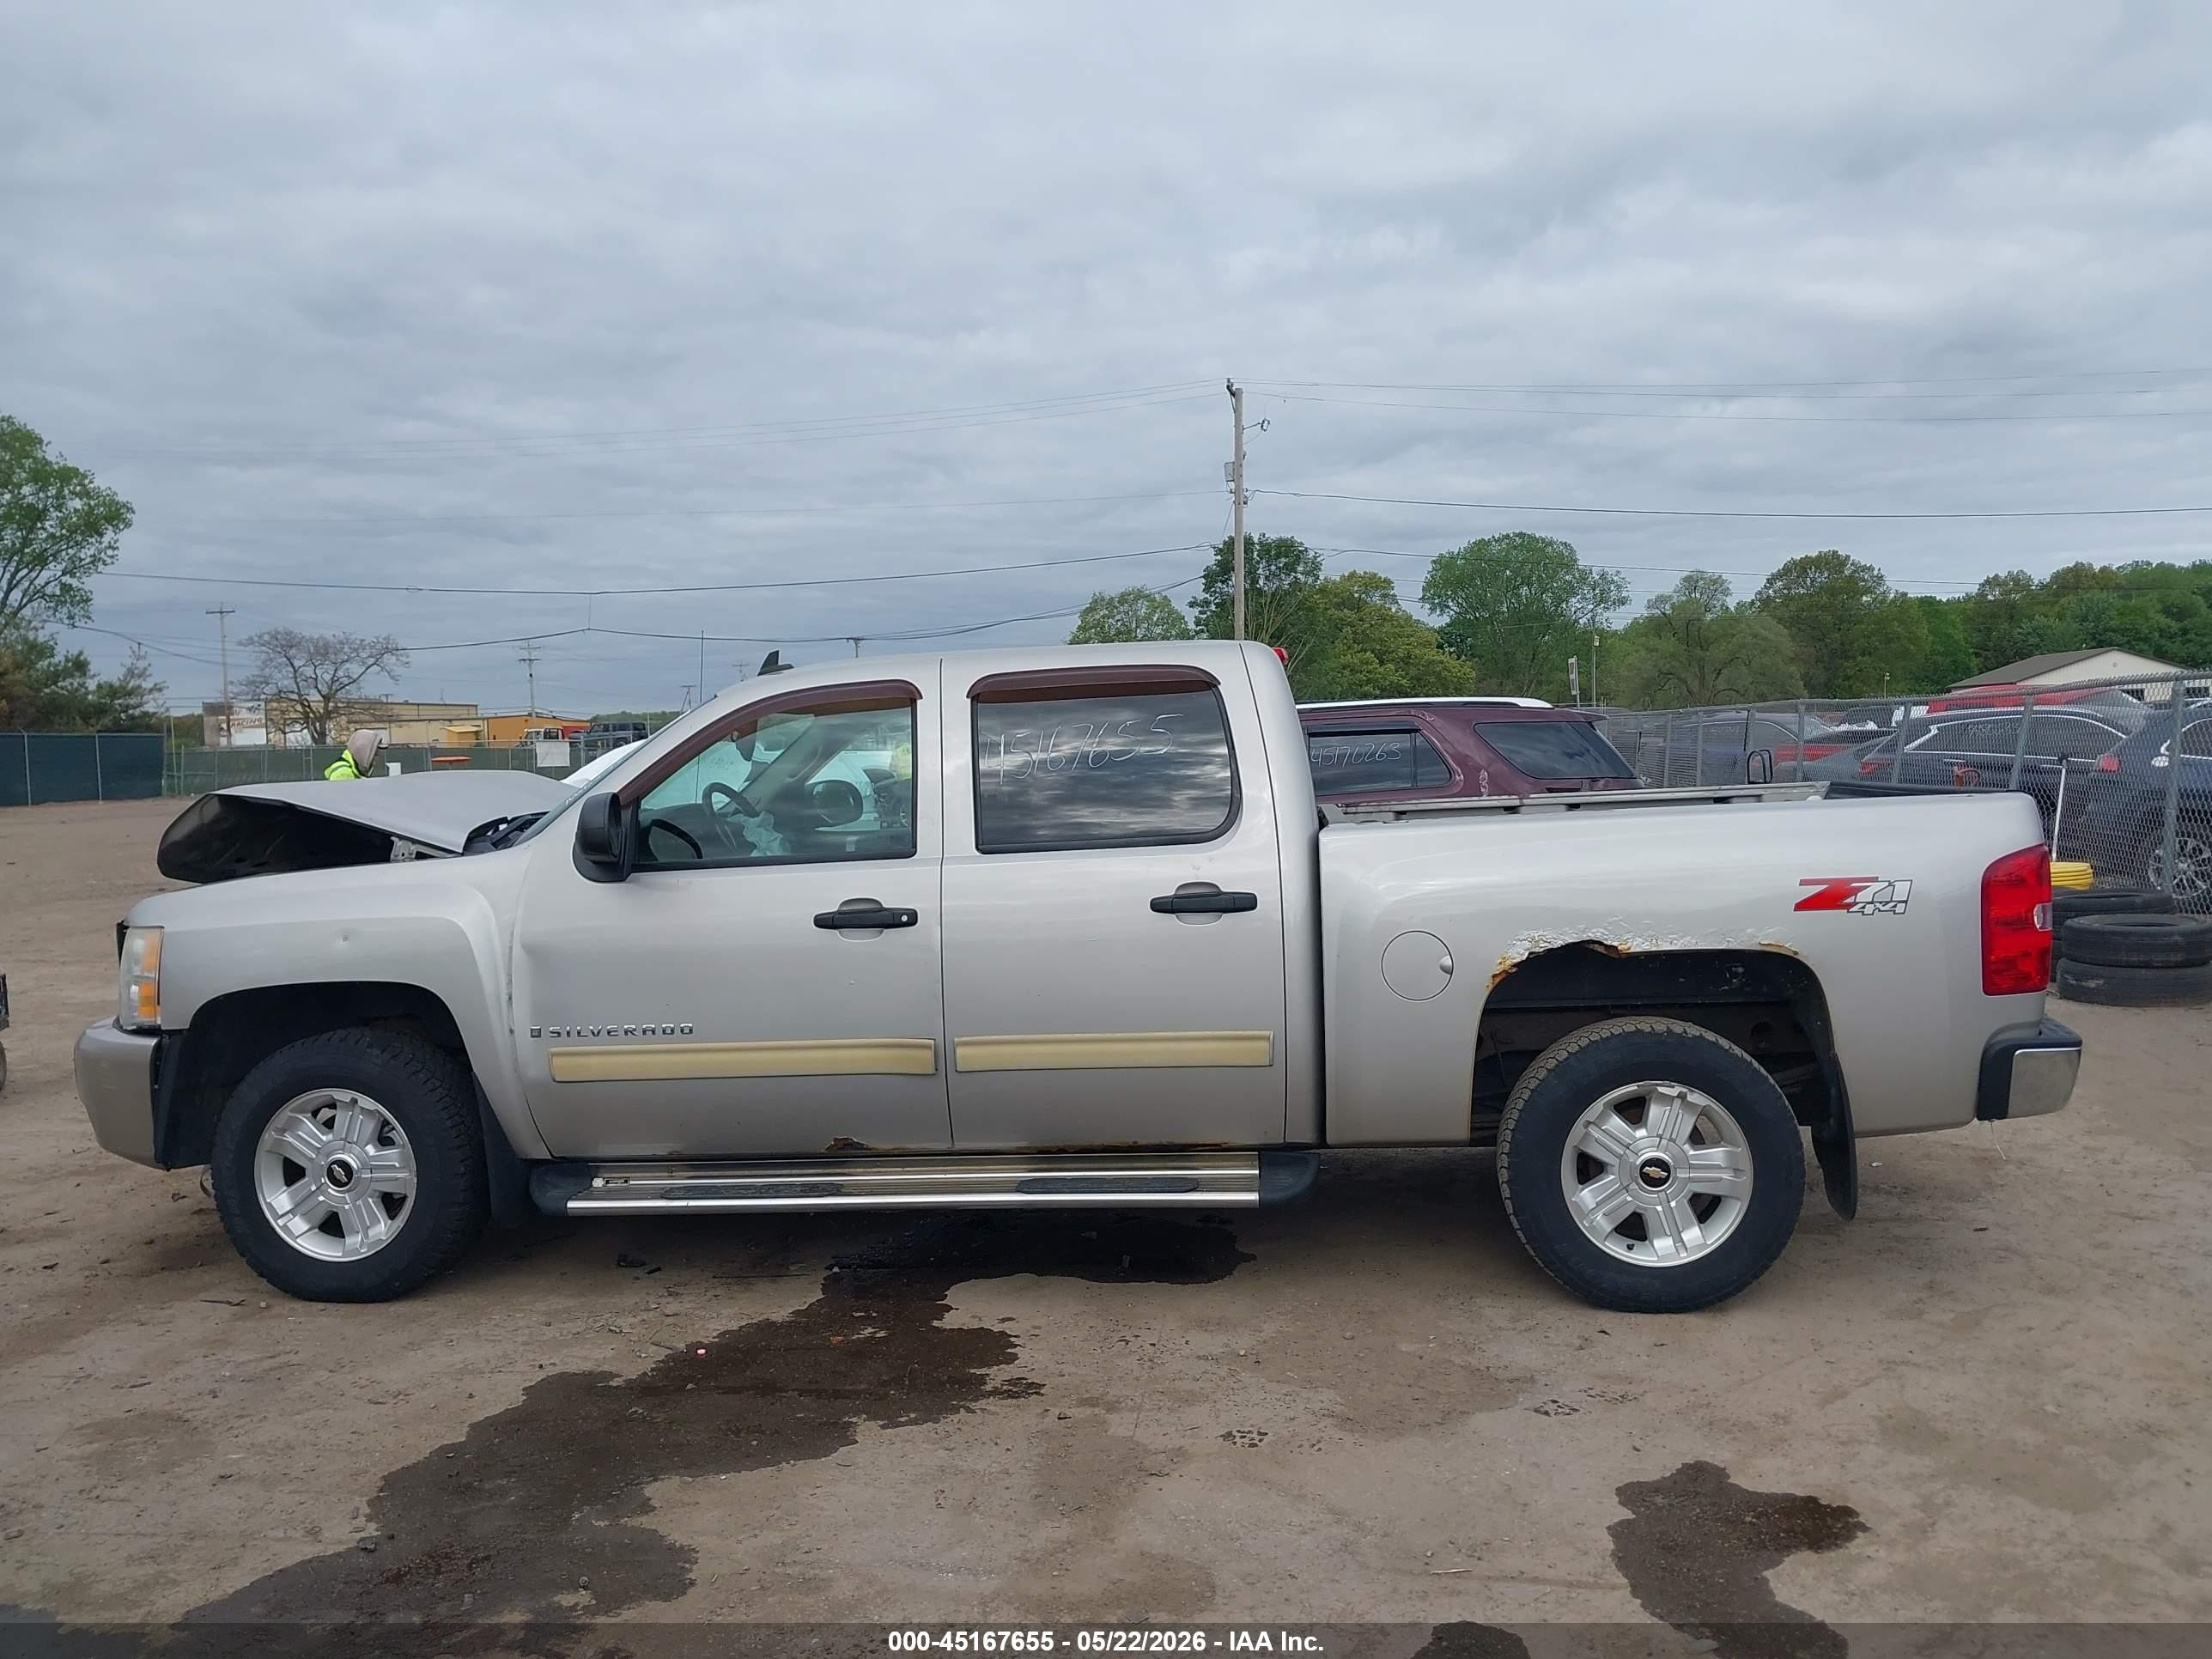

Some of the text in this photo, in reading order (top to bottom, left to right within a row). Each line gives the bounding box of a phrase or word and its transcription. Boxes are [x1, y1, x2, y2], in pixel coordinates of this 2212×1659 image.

[981, 714, 1184, 786] 45167655
[1310, 741, 1402, 768] 45170263
[1793, 876, 1913, 912] Z71
[548, 1022, 695, 1039] SILVERADO
